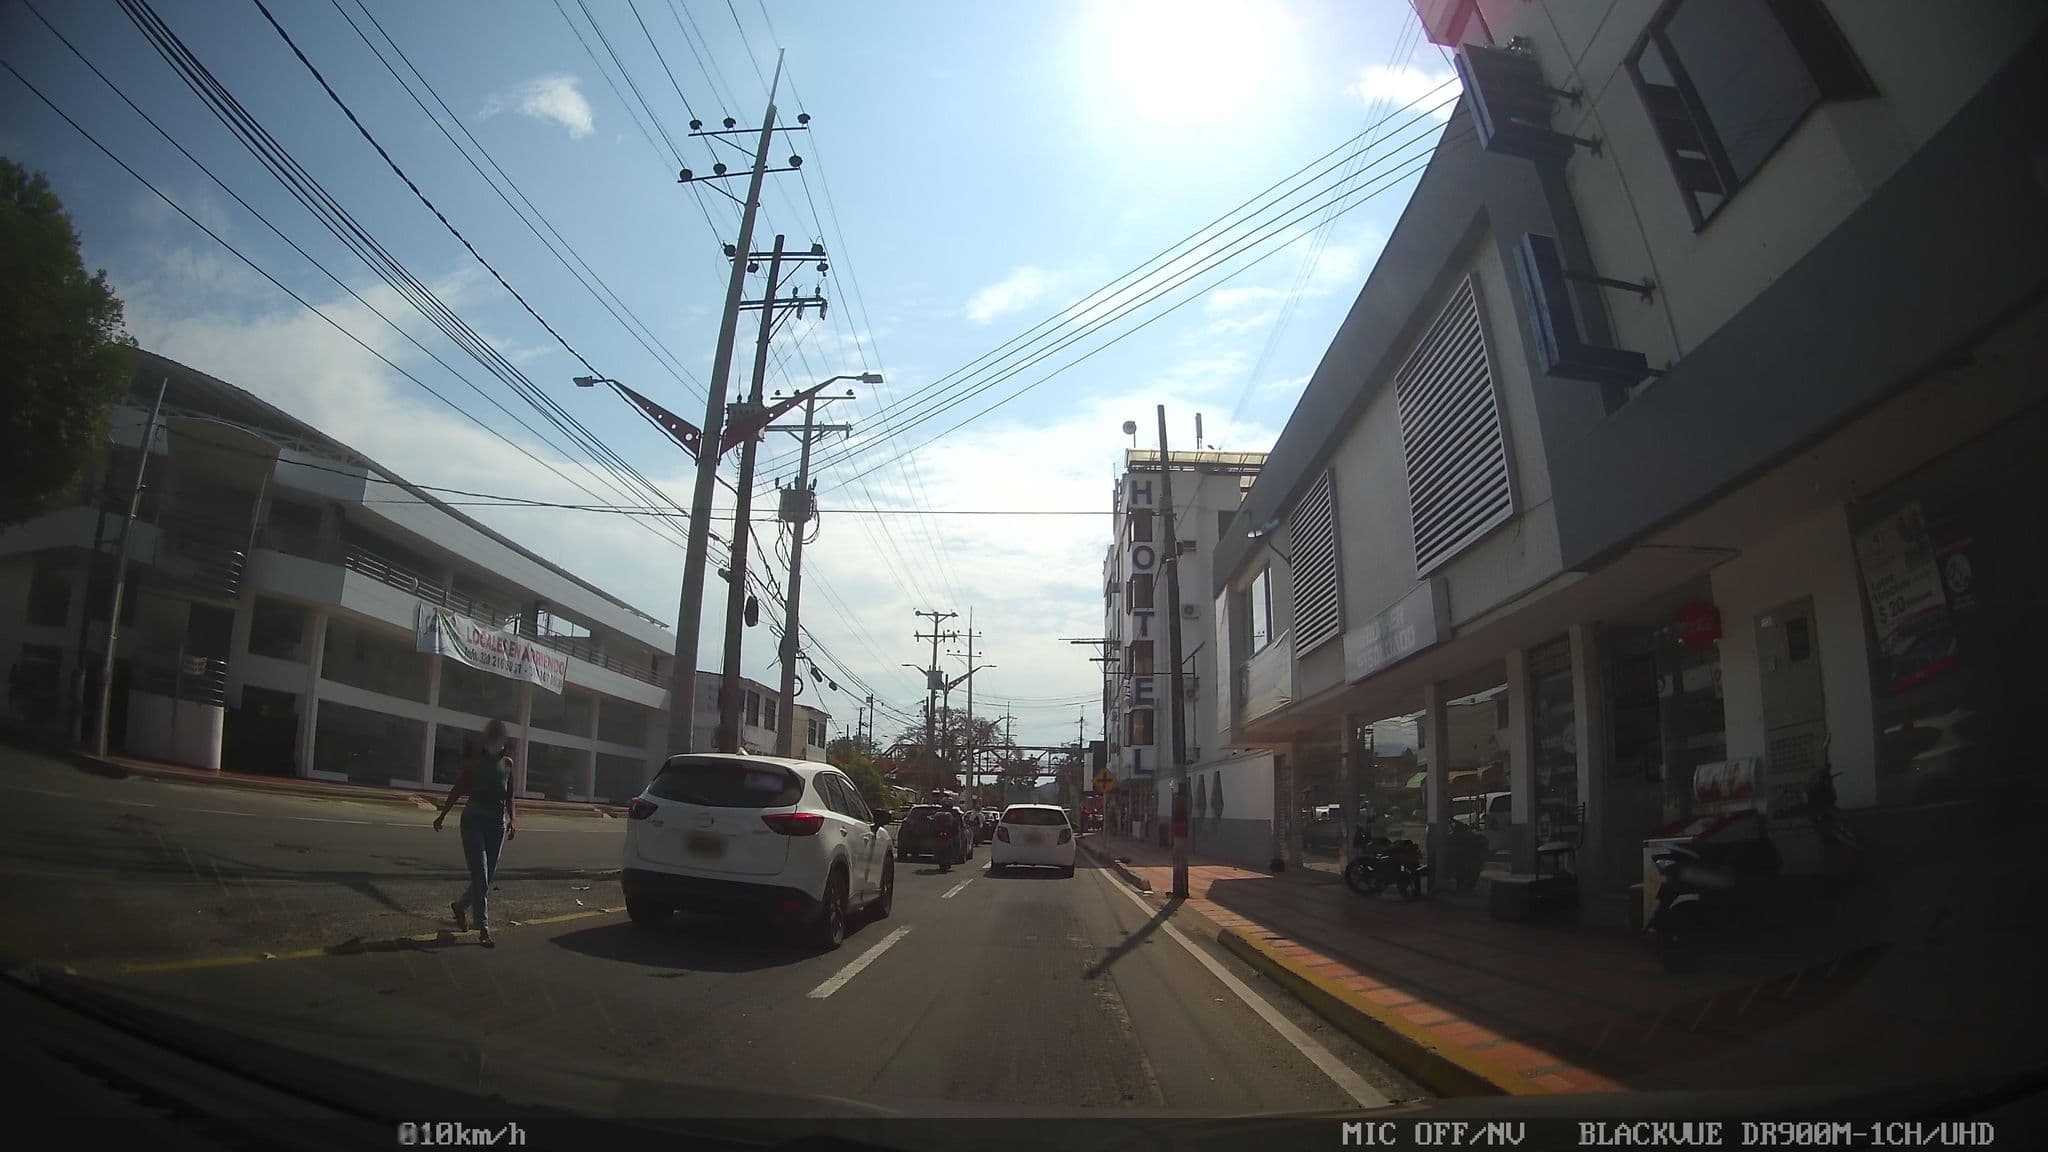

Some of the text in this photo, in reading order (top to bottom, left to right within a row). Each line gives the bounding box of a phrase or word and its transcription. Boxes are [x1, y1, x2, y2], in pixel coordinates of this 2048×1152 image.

[466, 626, 508, 654] LOCALES
[509, 640, 521, 659] EN
[521, 645, 565, 675] ARRIENDO
[1131, 480, 1155, 775] HOTEL
